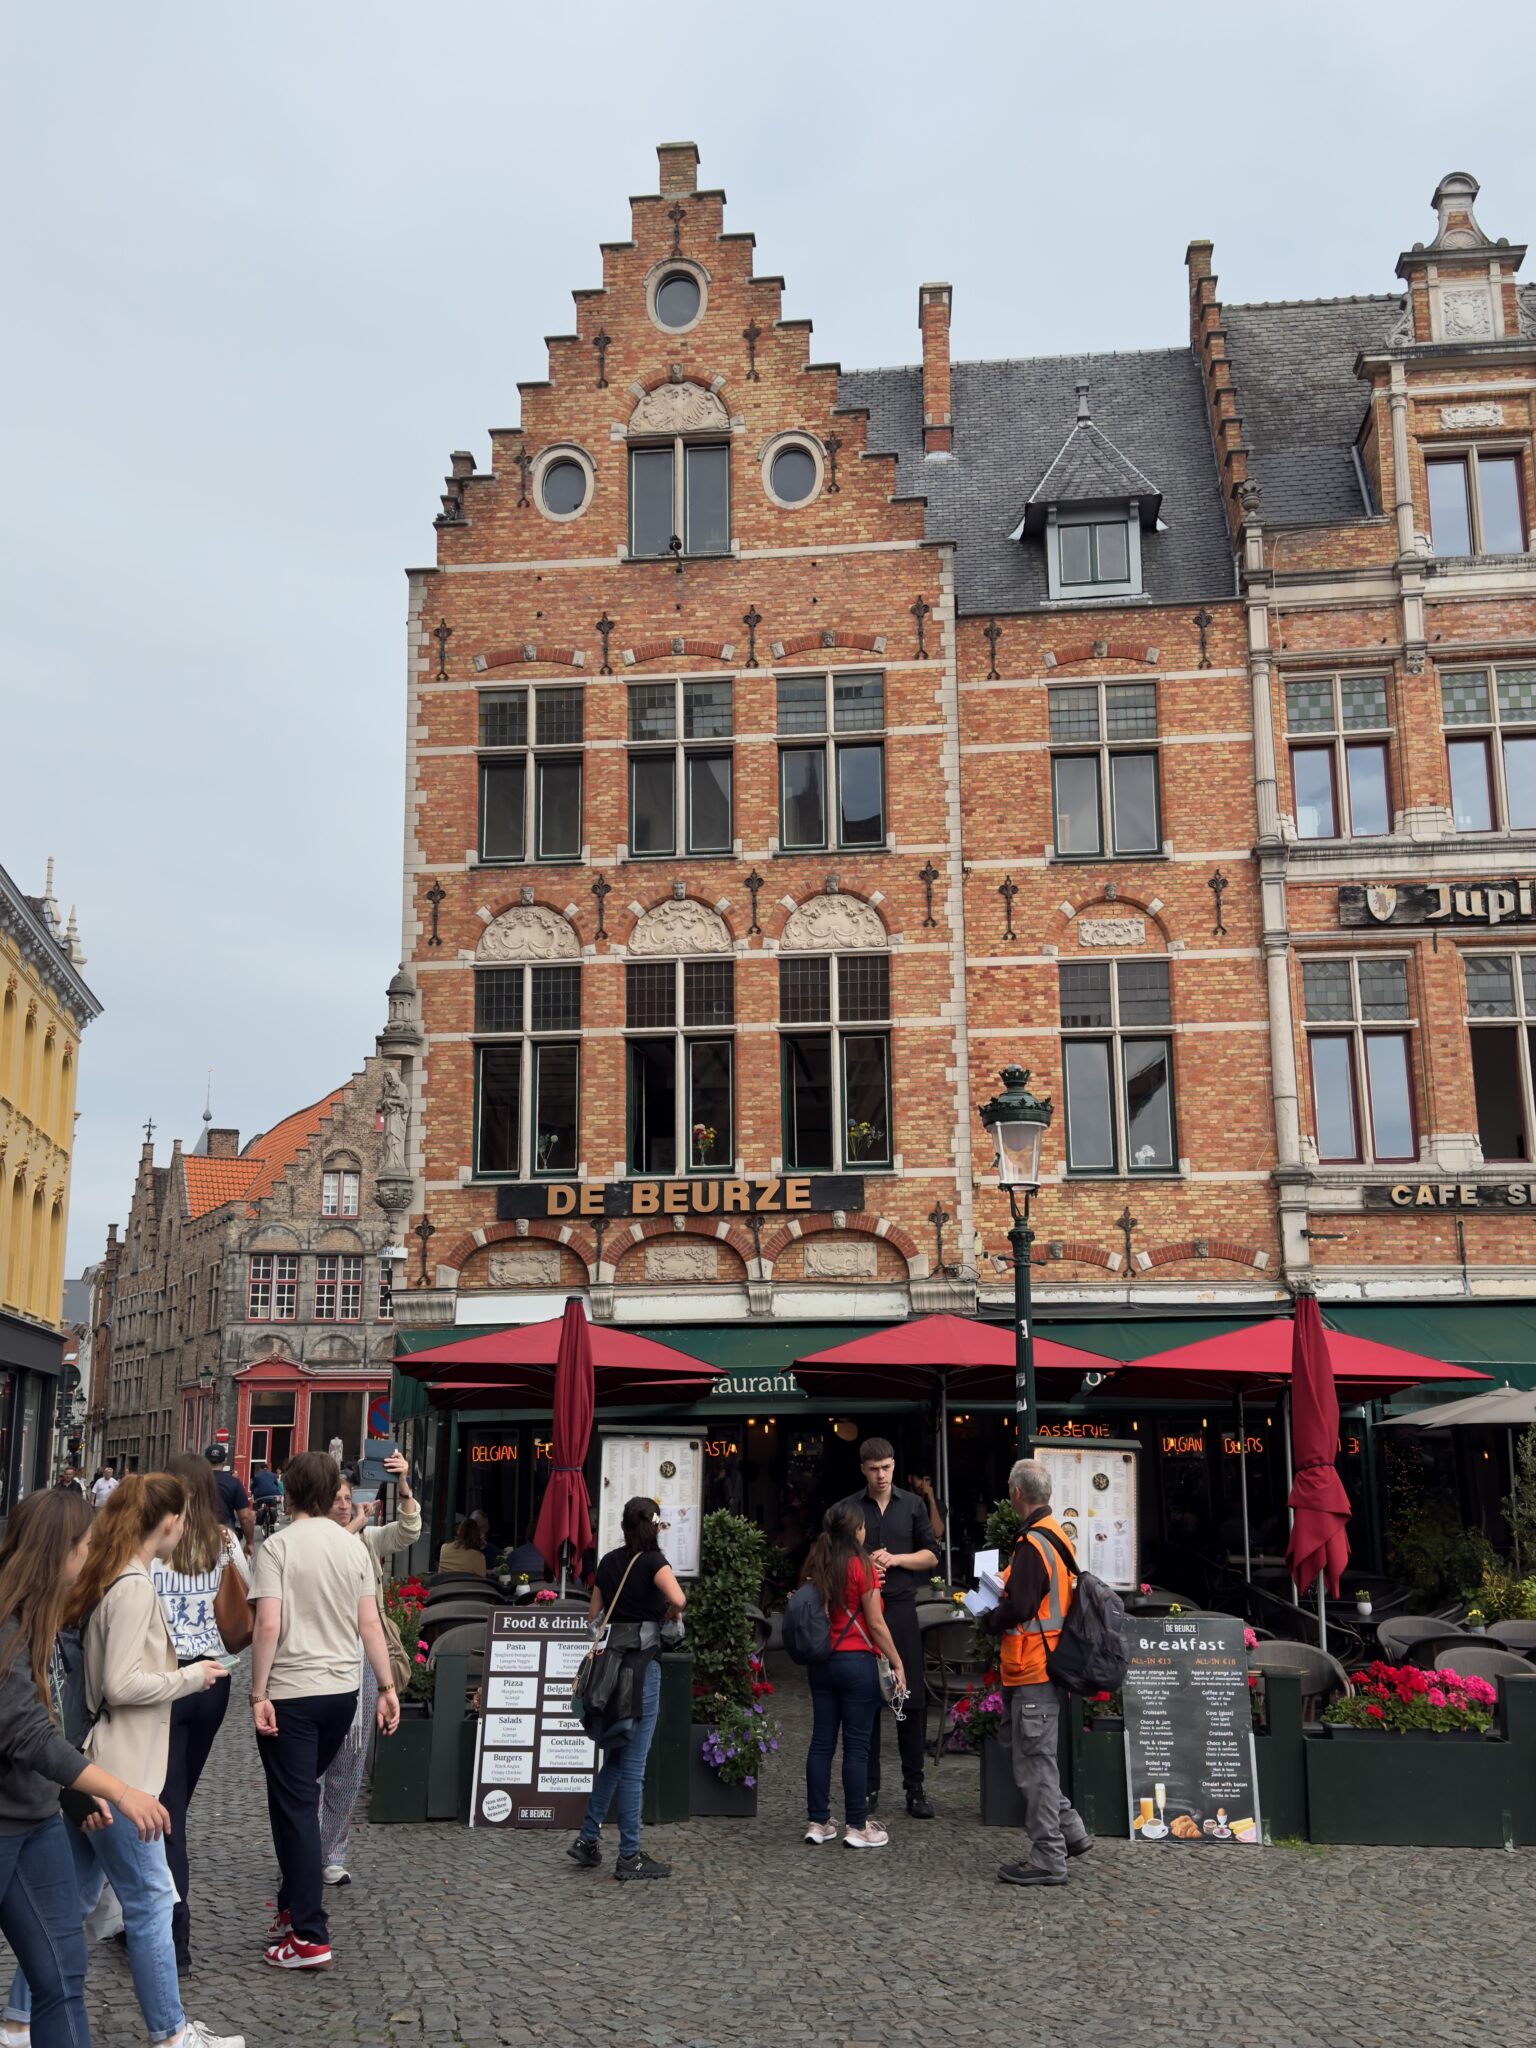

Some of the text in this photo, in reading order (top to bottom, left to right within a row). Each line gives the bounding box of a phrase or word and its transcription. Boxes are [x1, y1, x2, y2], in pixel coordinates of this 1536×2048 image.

[547, 1179, 812, 1216] DE BEURZE
[1391, 1184, 1478, 1206] CAFE
[710, 1372, 797, 1394] taurant
[1036, 1423, 1111, 1438] ASSERIE
[472, 1445, 518, 1462] BELGIAN
[704, 1441, 738, 1457] ASTA
[503, 1616, 588, 1629] Food & drink
[1166, 1624, 1196, 1632] DE BEURZE
[1140, 1638, 1225, 1651] Breakfast
[559, 1721, 580, 1729] Tapas
[493, 1754, 522, 1763] Burgers
[541, 1776, 568, 1784] Belgian
[521, 1810, 552, 1818] DE BEURZE
